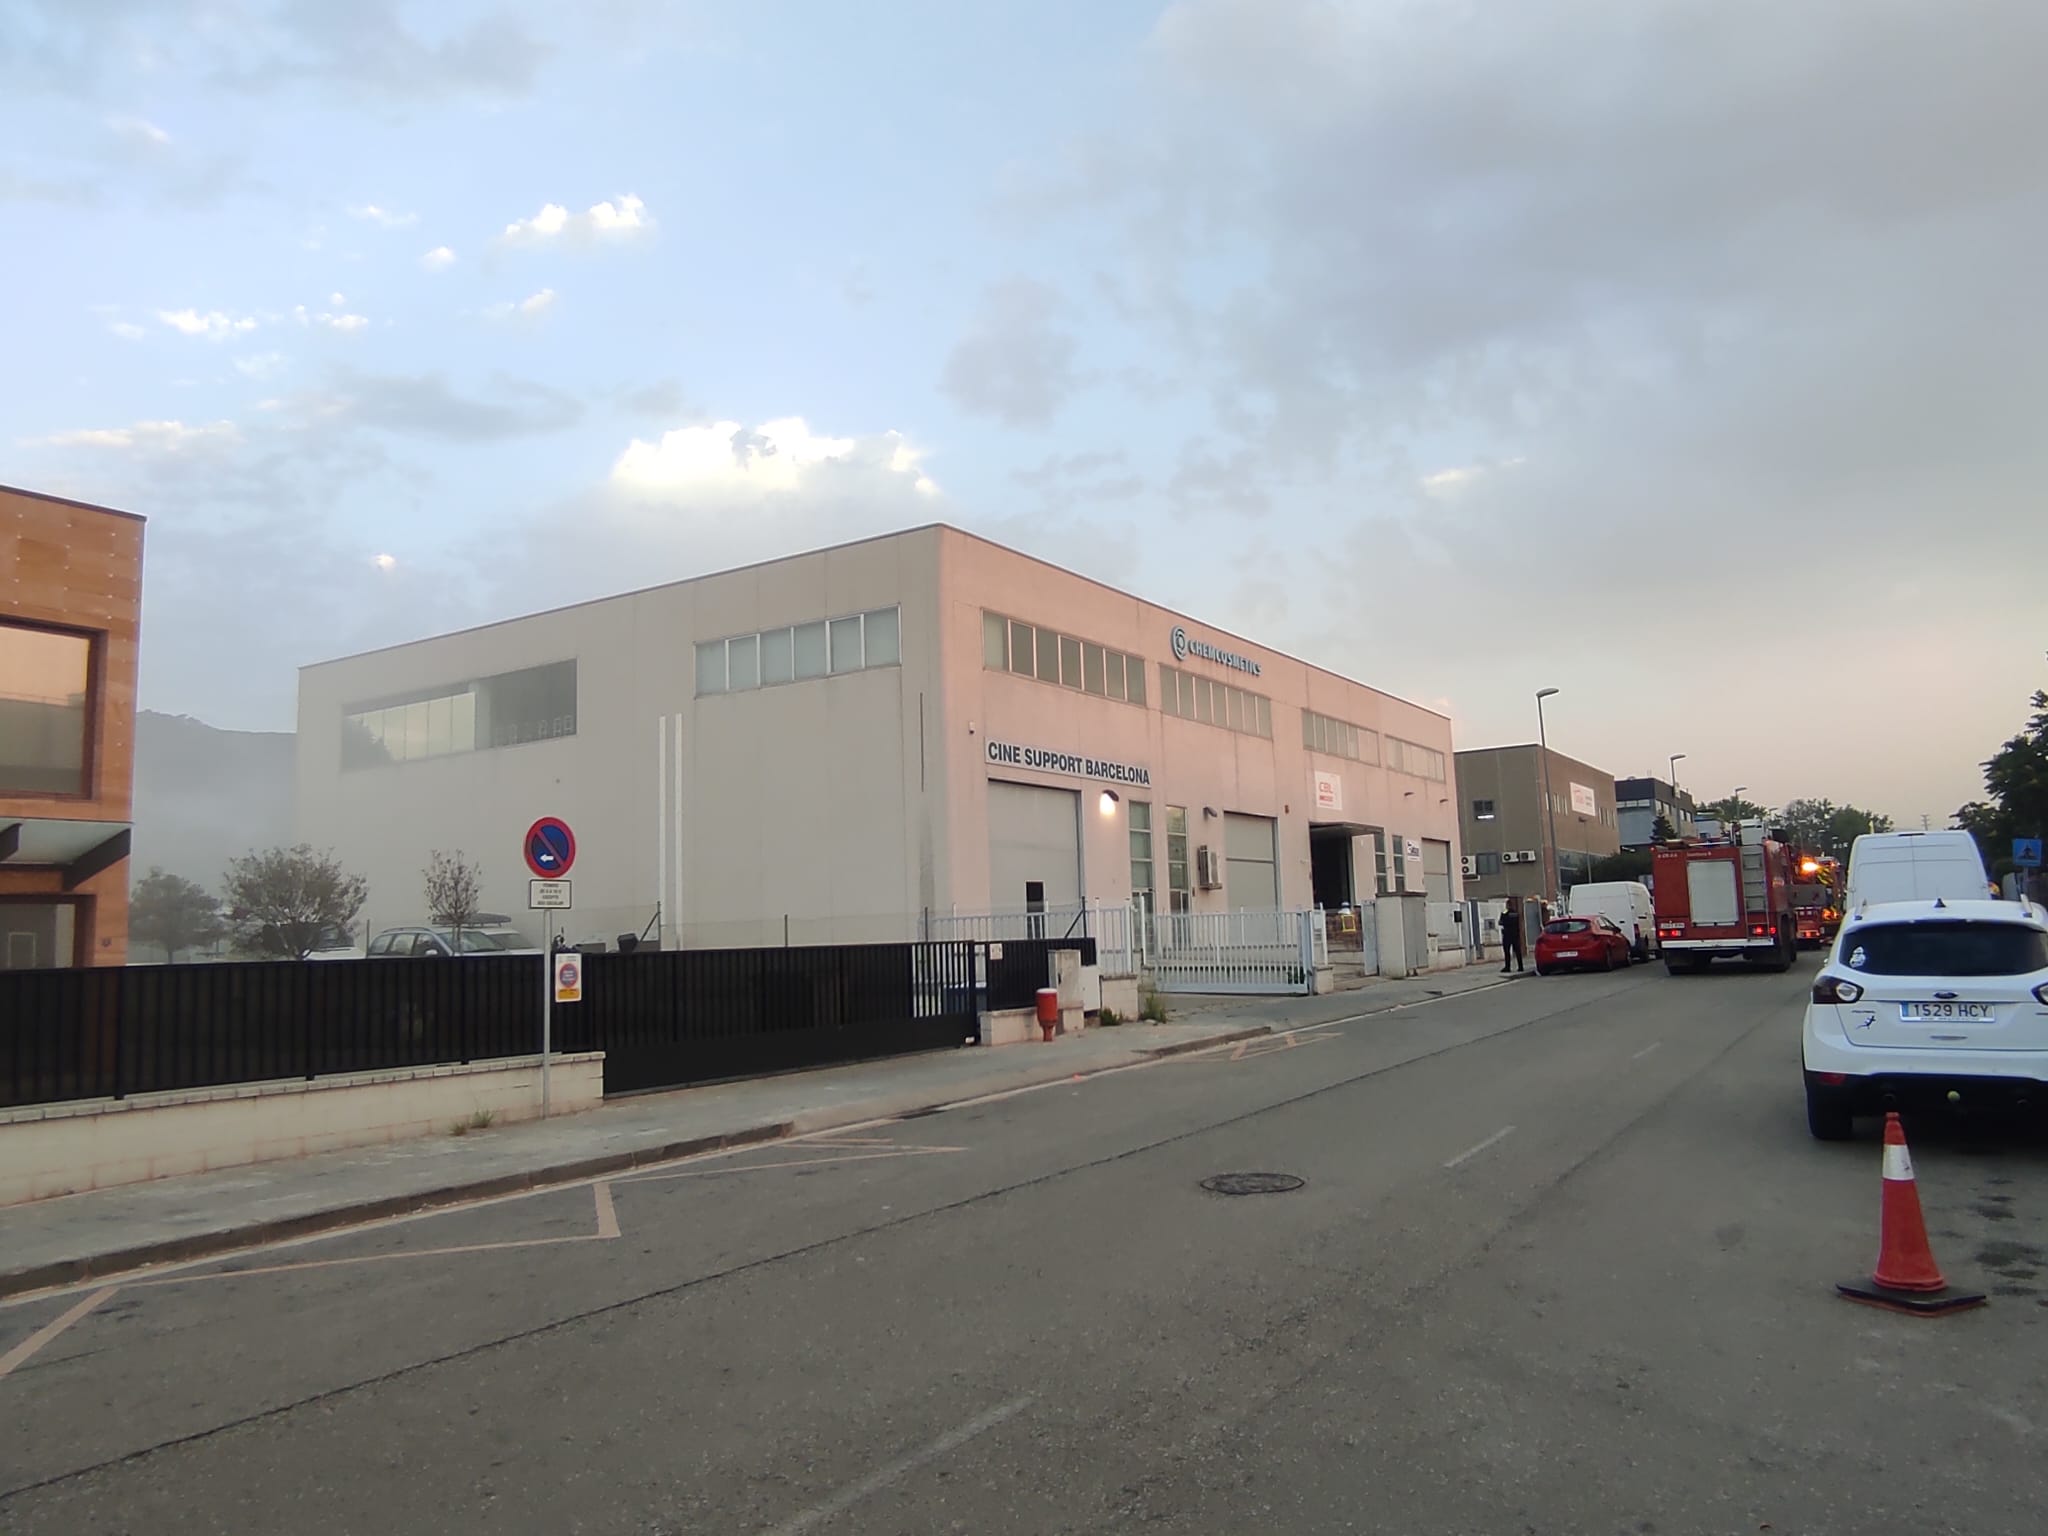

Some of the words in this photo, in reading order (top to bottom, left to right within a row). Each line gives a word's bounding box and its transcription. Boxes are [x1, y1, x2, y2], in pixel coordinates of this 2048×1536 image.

[1188, 640, 1262, 676] CHEMCOSMETICS
[988, 742, 1021, 763] CINE
[1025, 748, 1082, 774] SUPPORT
[1085, 759, 1150, 785] BARCELONA
[1914, 1004, 1952, 1017] 1529
[1958, 1004, 1989, 1017] HCY
